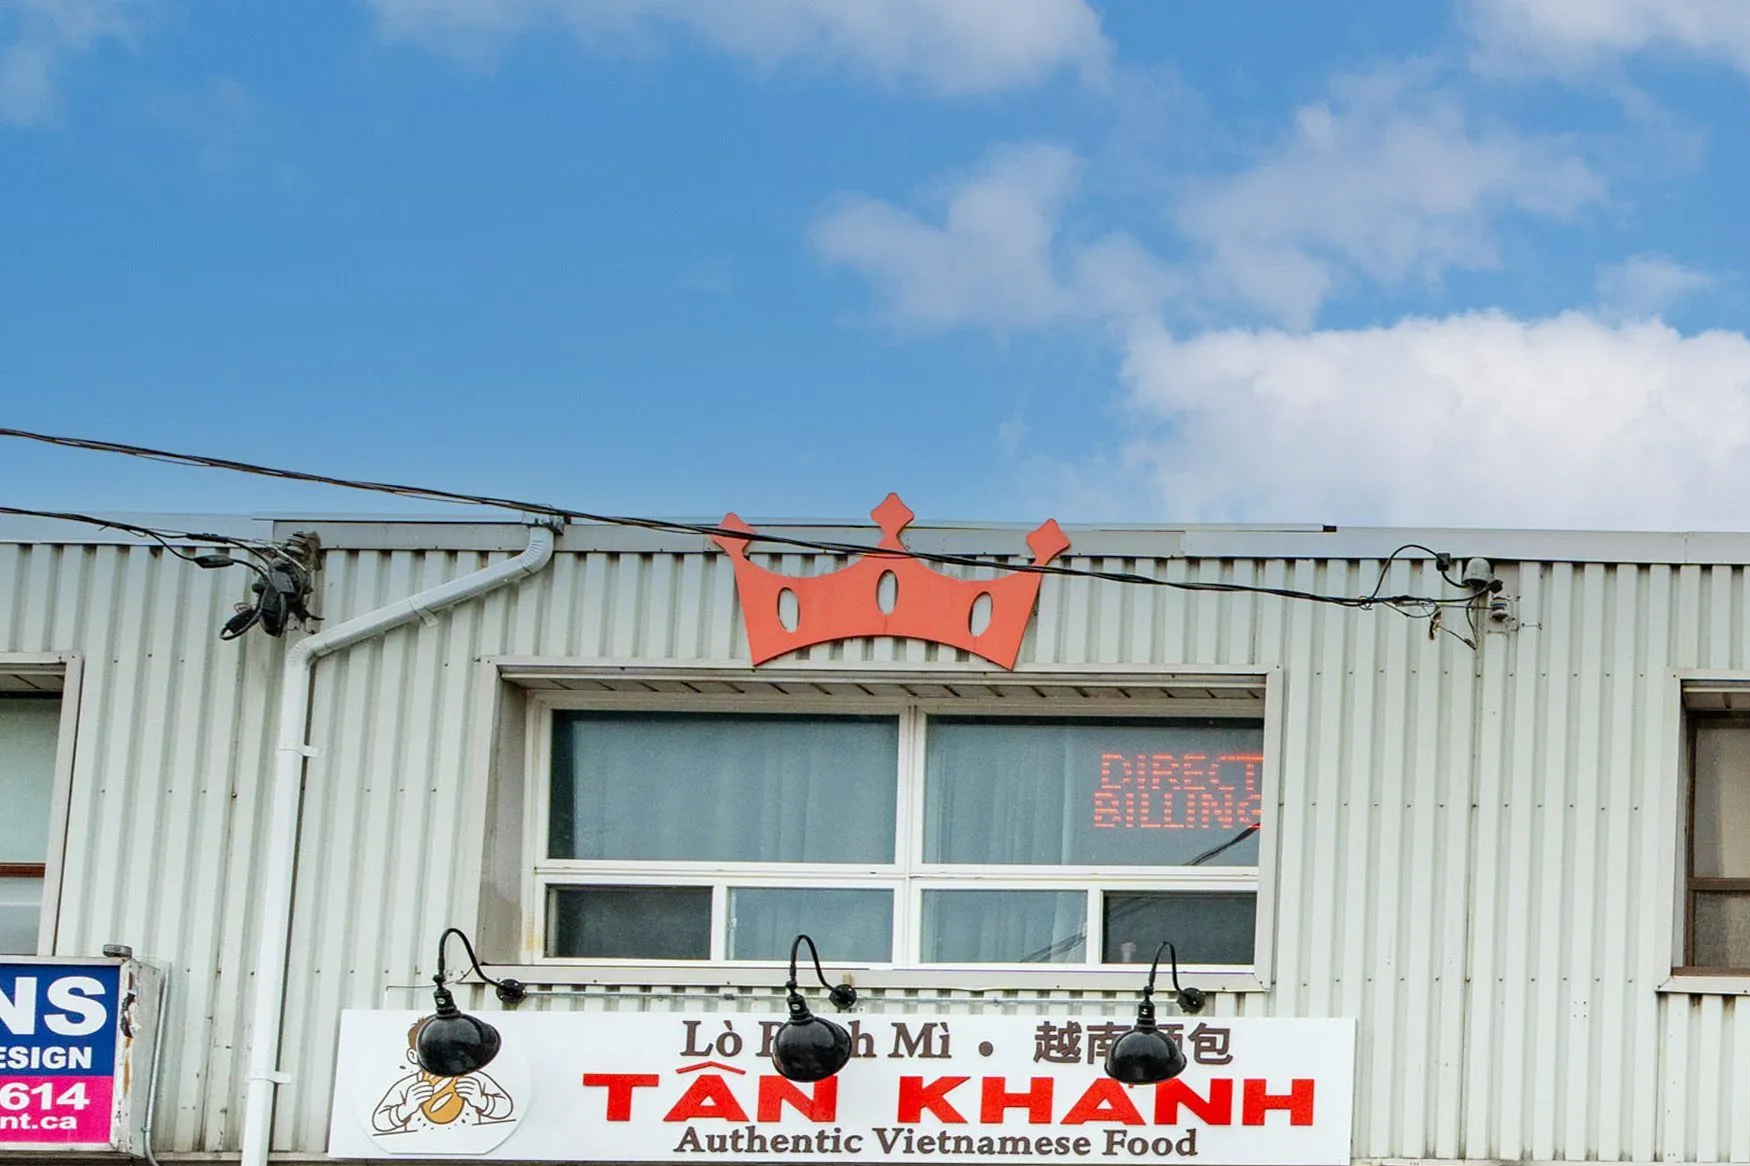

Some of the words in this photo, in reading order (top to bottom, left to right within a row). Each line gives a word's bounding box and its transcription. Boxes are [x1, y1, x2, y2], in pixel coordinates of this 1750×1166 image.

[1101, 754, 1264, 790] DIRECT
[1094, 792, 1263, 828] BILLING
[680, 1020, 743, 1057] Lò
[888, 1020, 952, 1058] Mì
[0, 1046, 92, 1069] SIGN
[583, 1061, 838, 1122] TÂN
[673, 1126, 863, 1154] Authentic
[872, 1127, 1092, 1156] Vietnamese
[1102, 1128, 1198, 1156] Food
